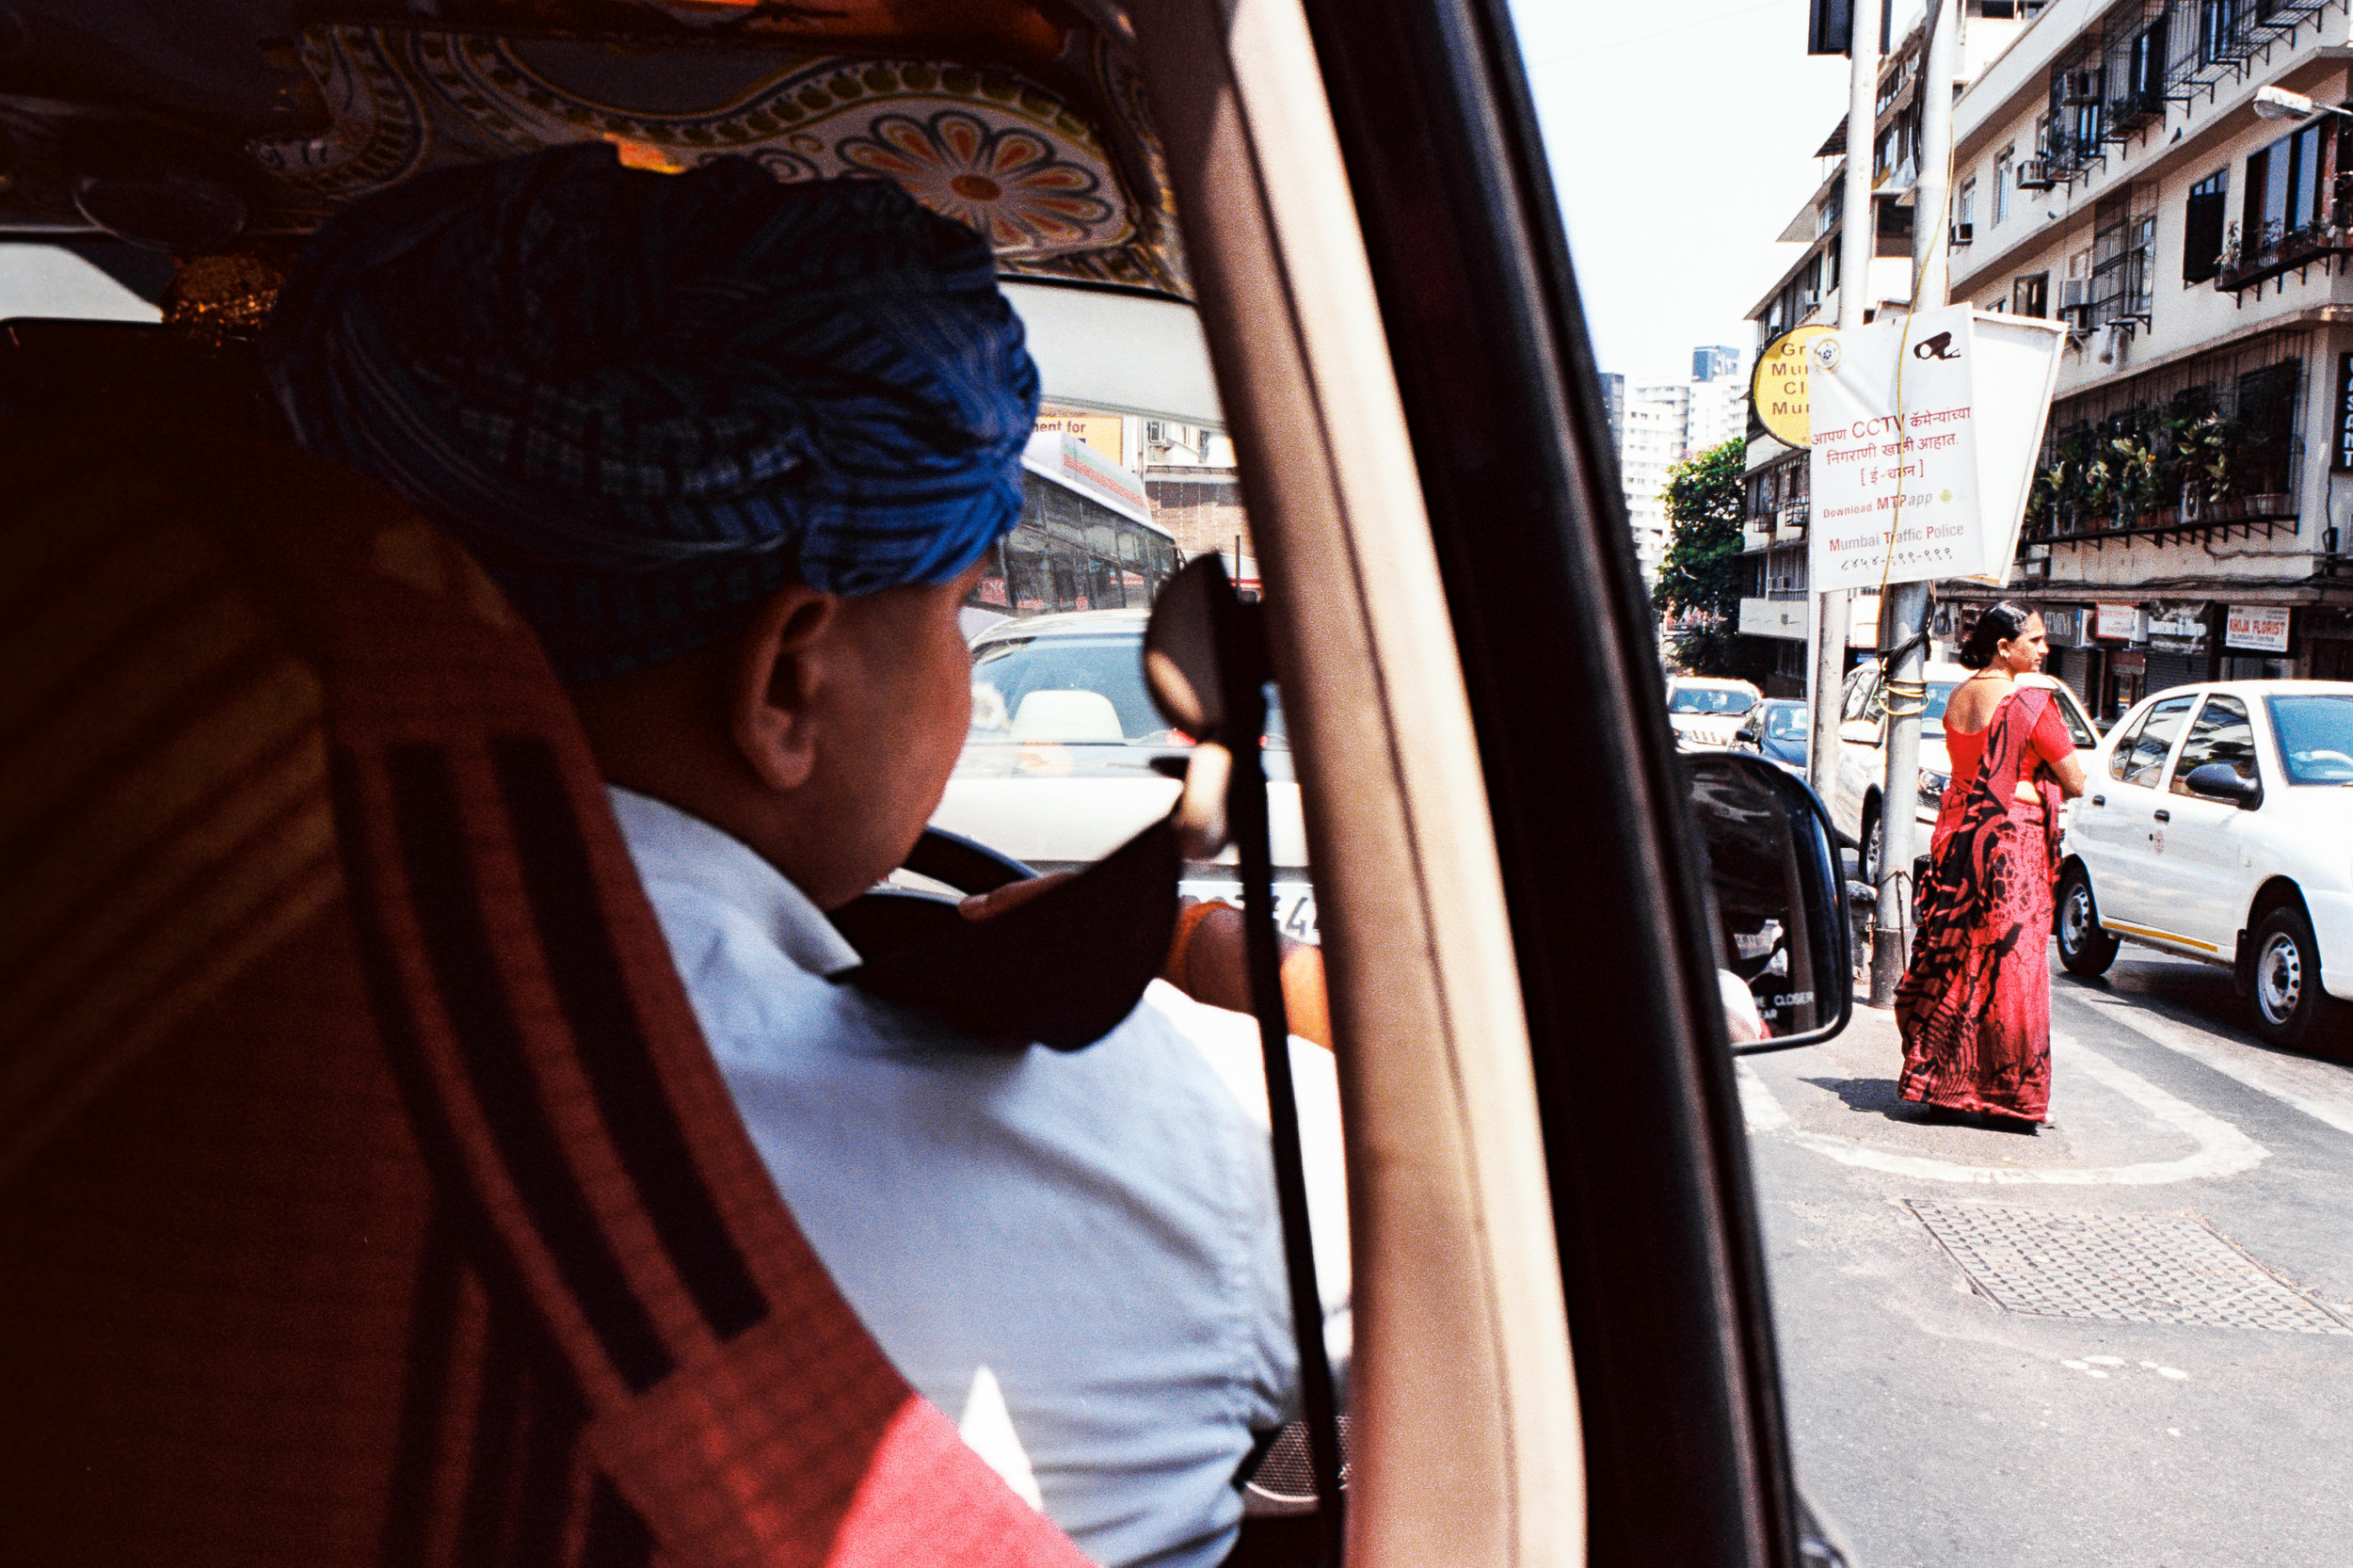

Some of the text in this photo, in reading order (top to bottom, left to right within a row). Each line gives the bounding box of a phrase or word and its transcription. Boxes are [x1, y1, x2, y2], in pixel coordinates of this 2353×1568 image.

[1781, 343, 1807, 356] Gr
[1771, 363, 1808, 376] Mu
[1784, 381, 1804, 394] Cl
[1771, 402, 1809, 414] Mu
[1066, 421, 1086, 433] for
[1811, 429, 1848, 446] आपण
[1852, 413, 1905, 439] CCTV
[1826, 442, 1877, 465] निगराणी
[1823, 504, 1872, 519] Download
[1830, 535, 1880, 552] Mumbai
[1927, 524, 1964, 539] Police
[1774, 991, 1815, 1006] CLOSER
